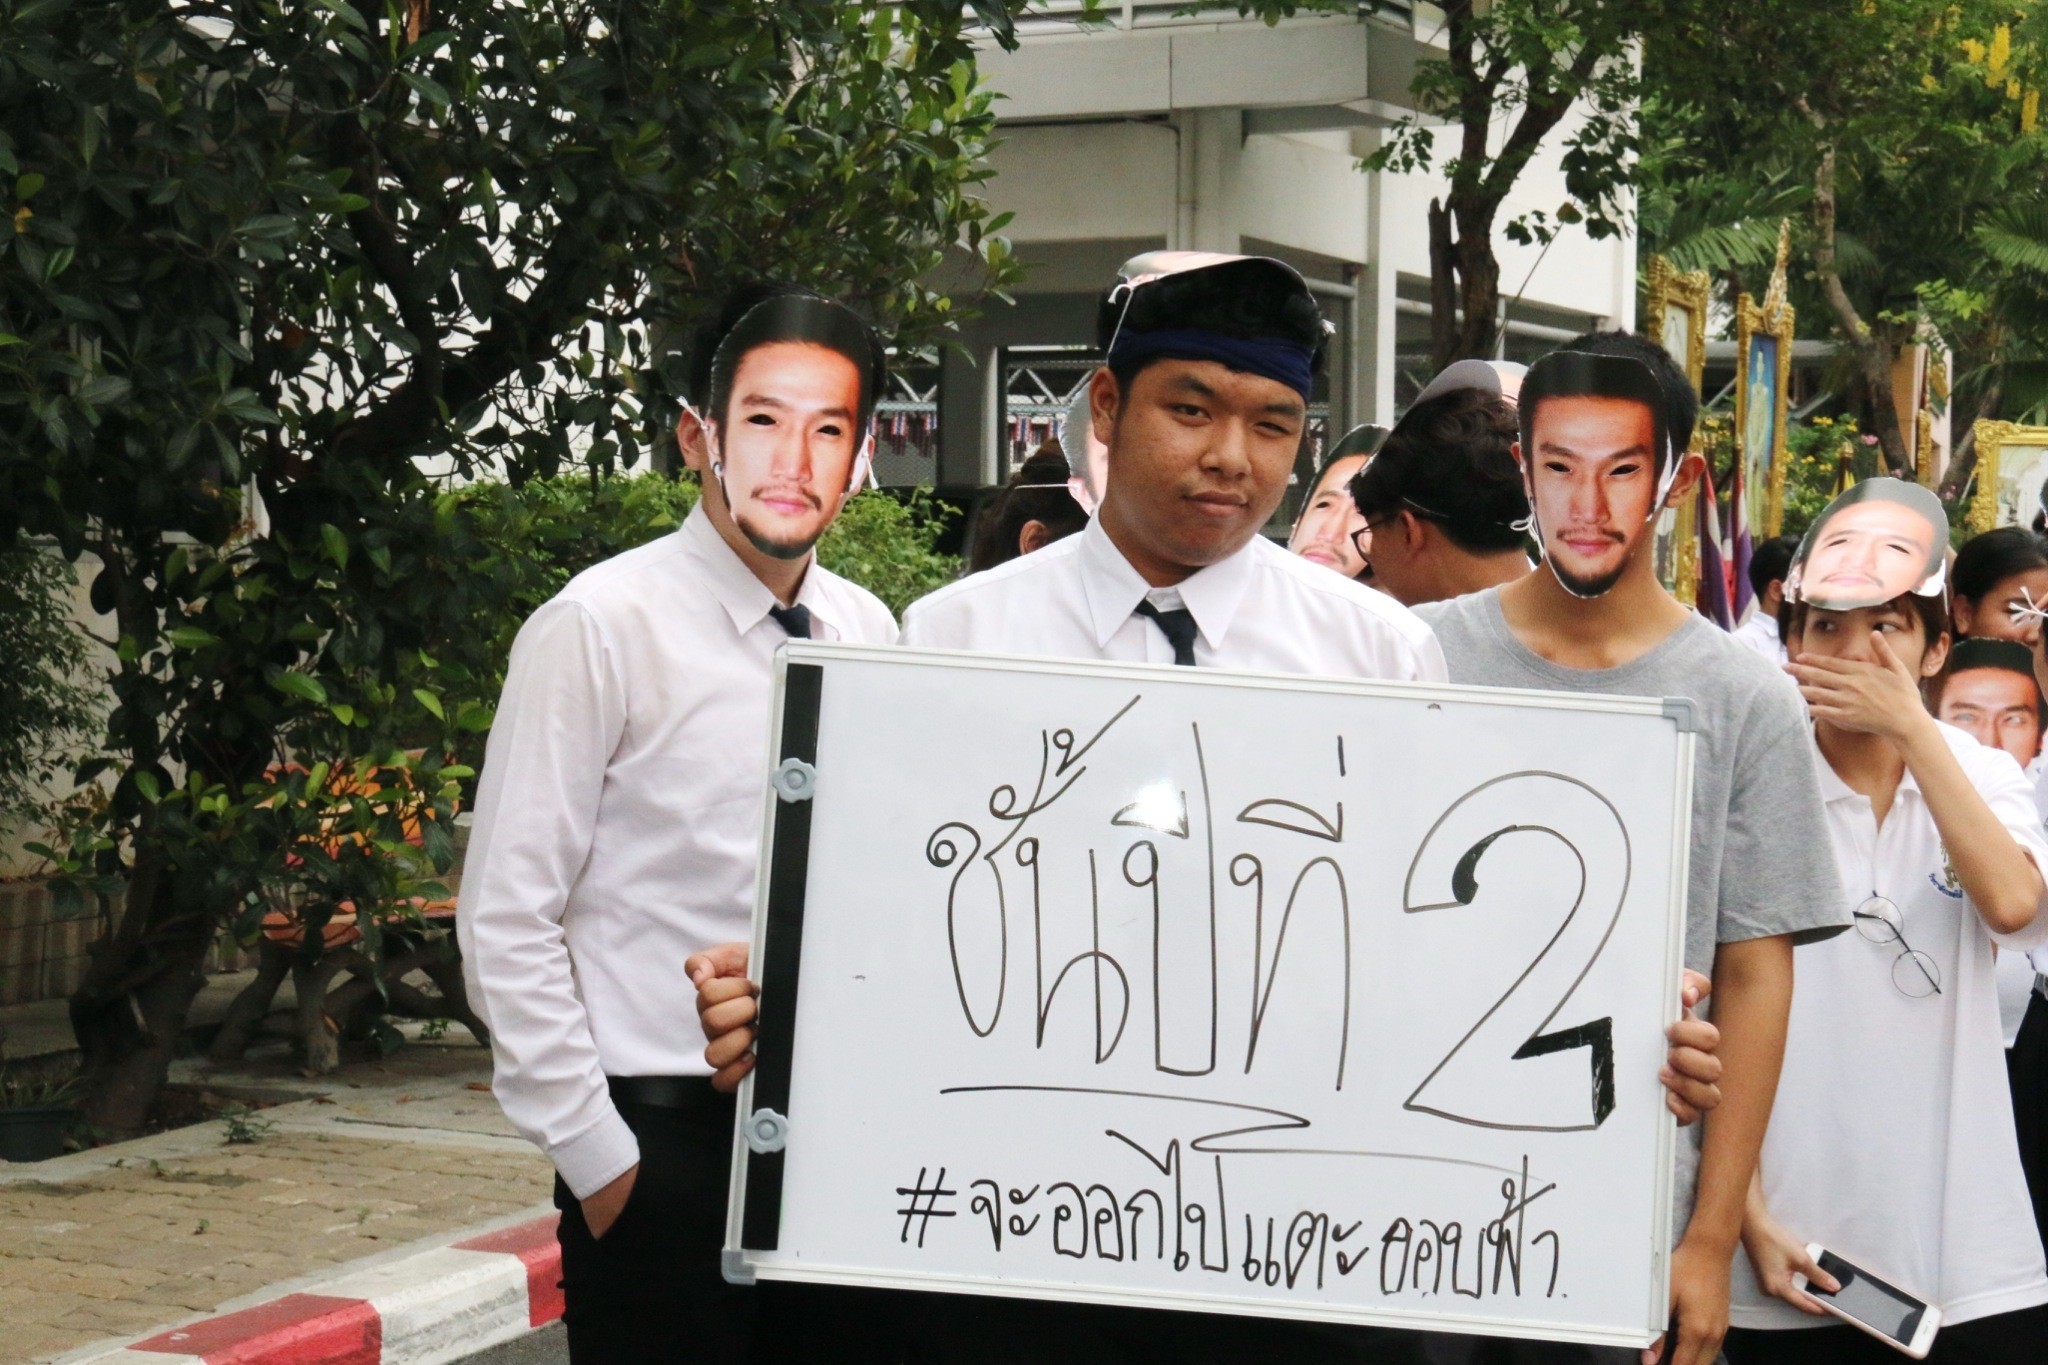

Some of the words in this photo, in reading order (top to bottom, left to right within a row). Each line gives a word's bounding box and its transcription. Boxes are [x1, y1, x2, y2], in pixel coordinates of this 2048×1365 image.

[926, 694, 1351, 1092] ชั้นปีที่
[1403, 770, 1633, 1131] 2
